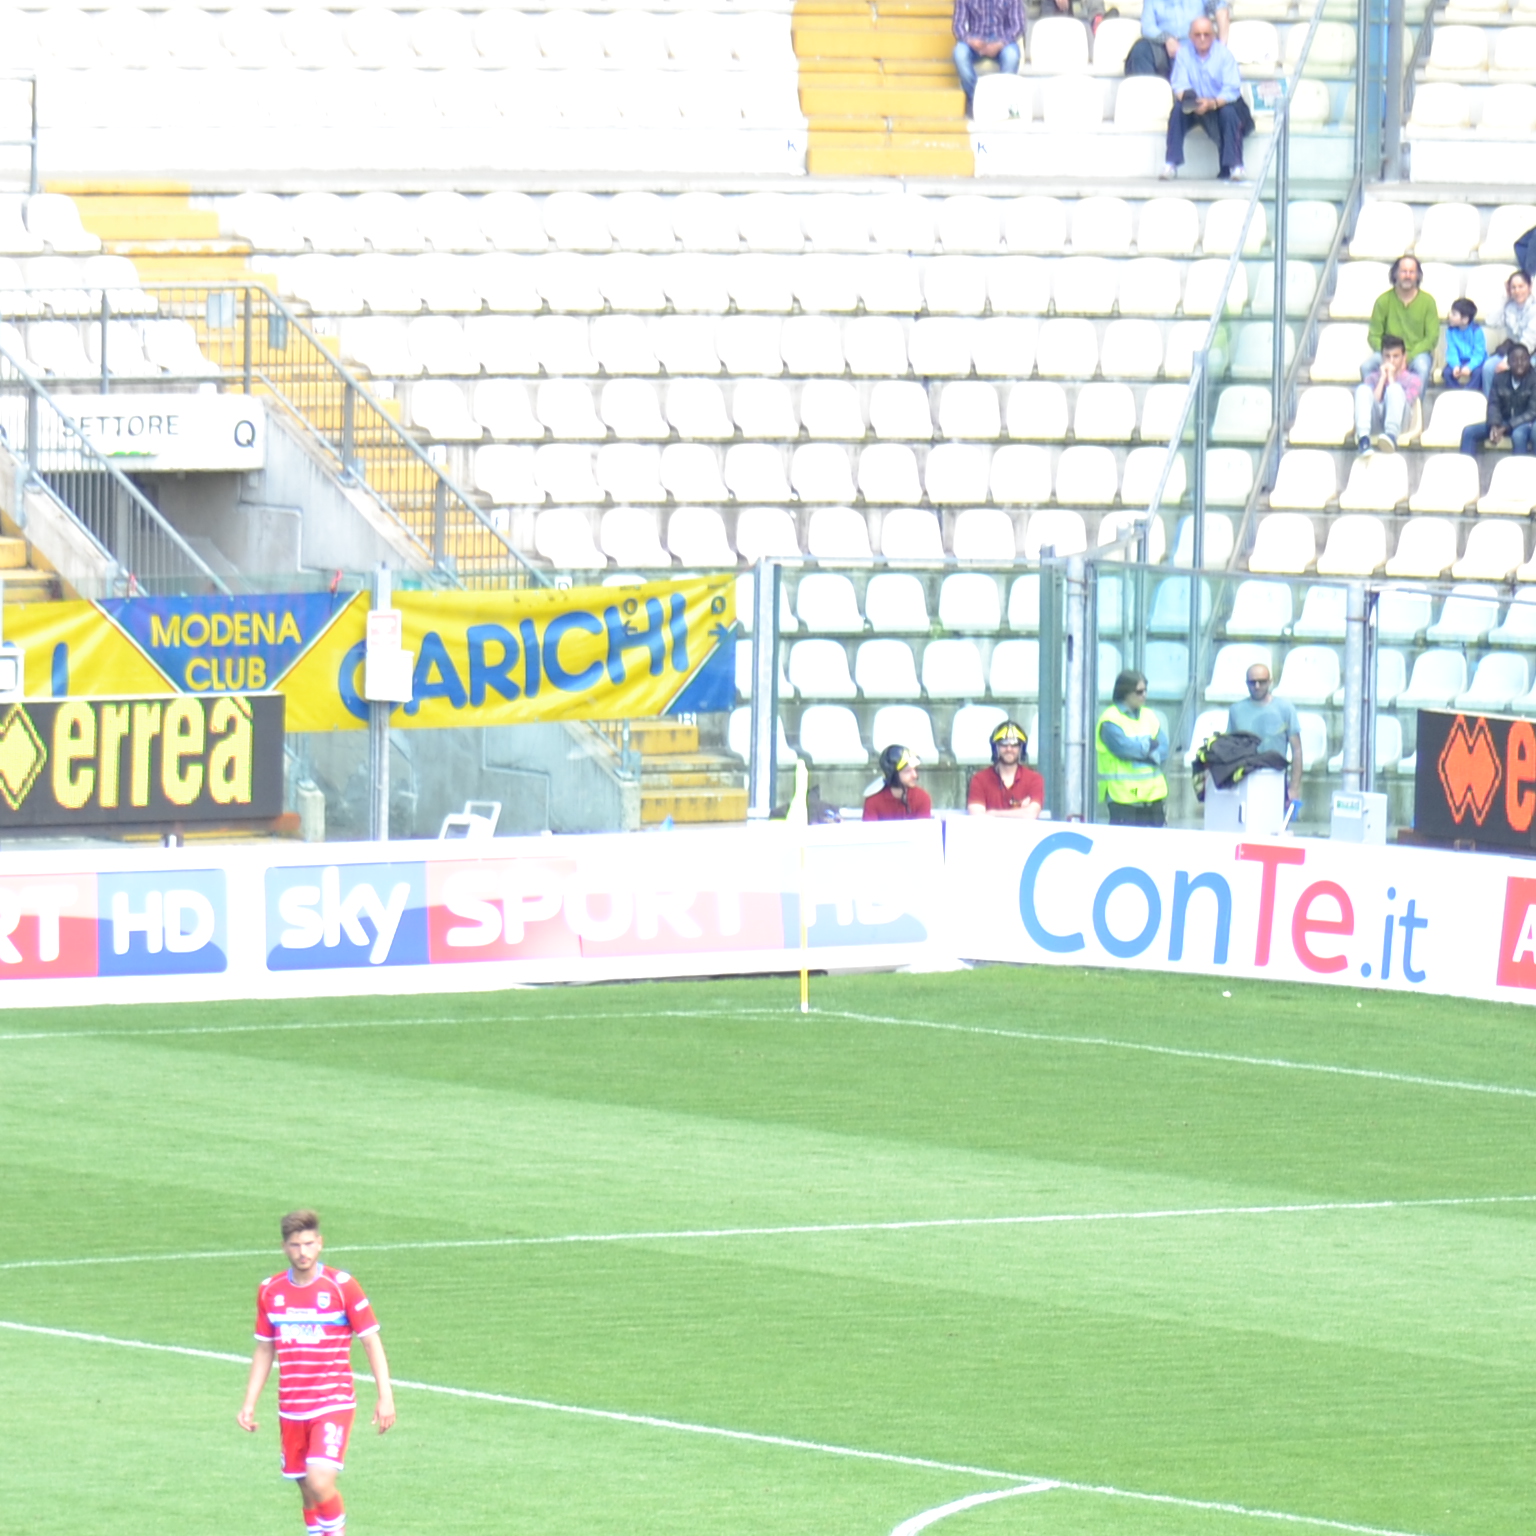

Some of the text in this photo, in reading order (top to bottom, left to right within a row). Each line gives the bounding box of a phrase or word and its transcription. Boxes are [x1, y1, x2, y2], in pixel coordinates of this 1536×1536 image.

[234, 420, 256, 449] Q
[150, 611, 302, 648] MODENA
[186, 657, 267, 692] CLUB
[111, 888, 216, 957] HD
[279, 865, 412, 965] sky
[1018, 832, 1429, 984] ConTe.it
